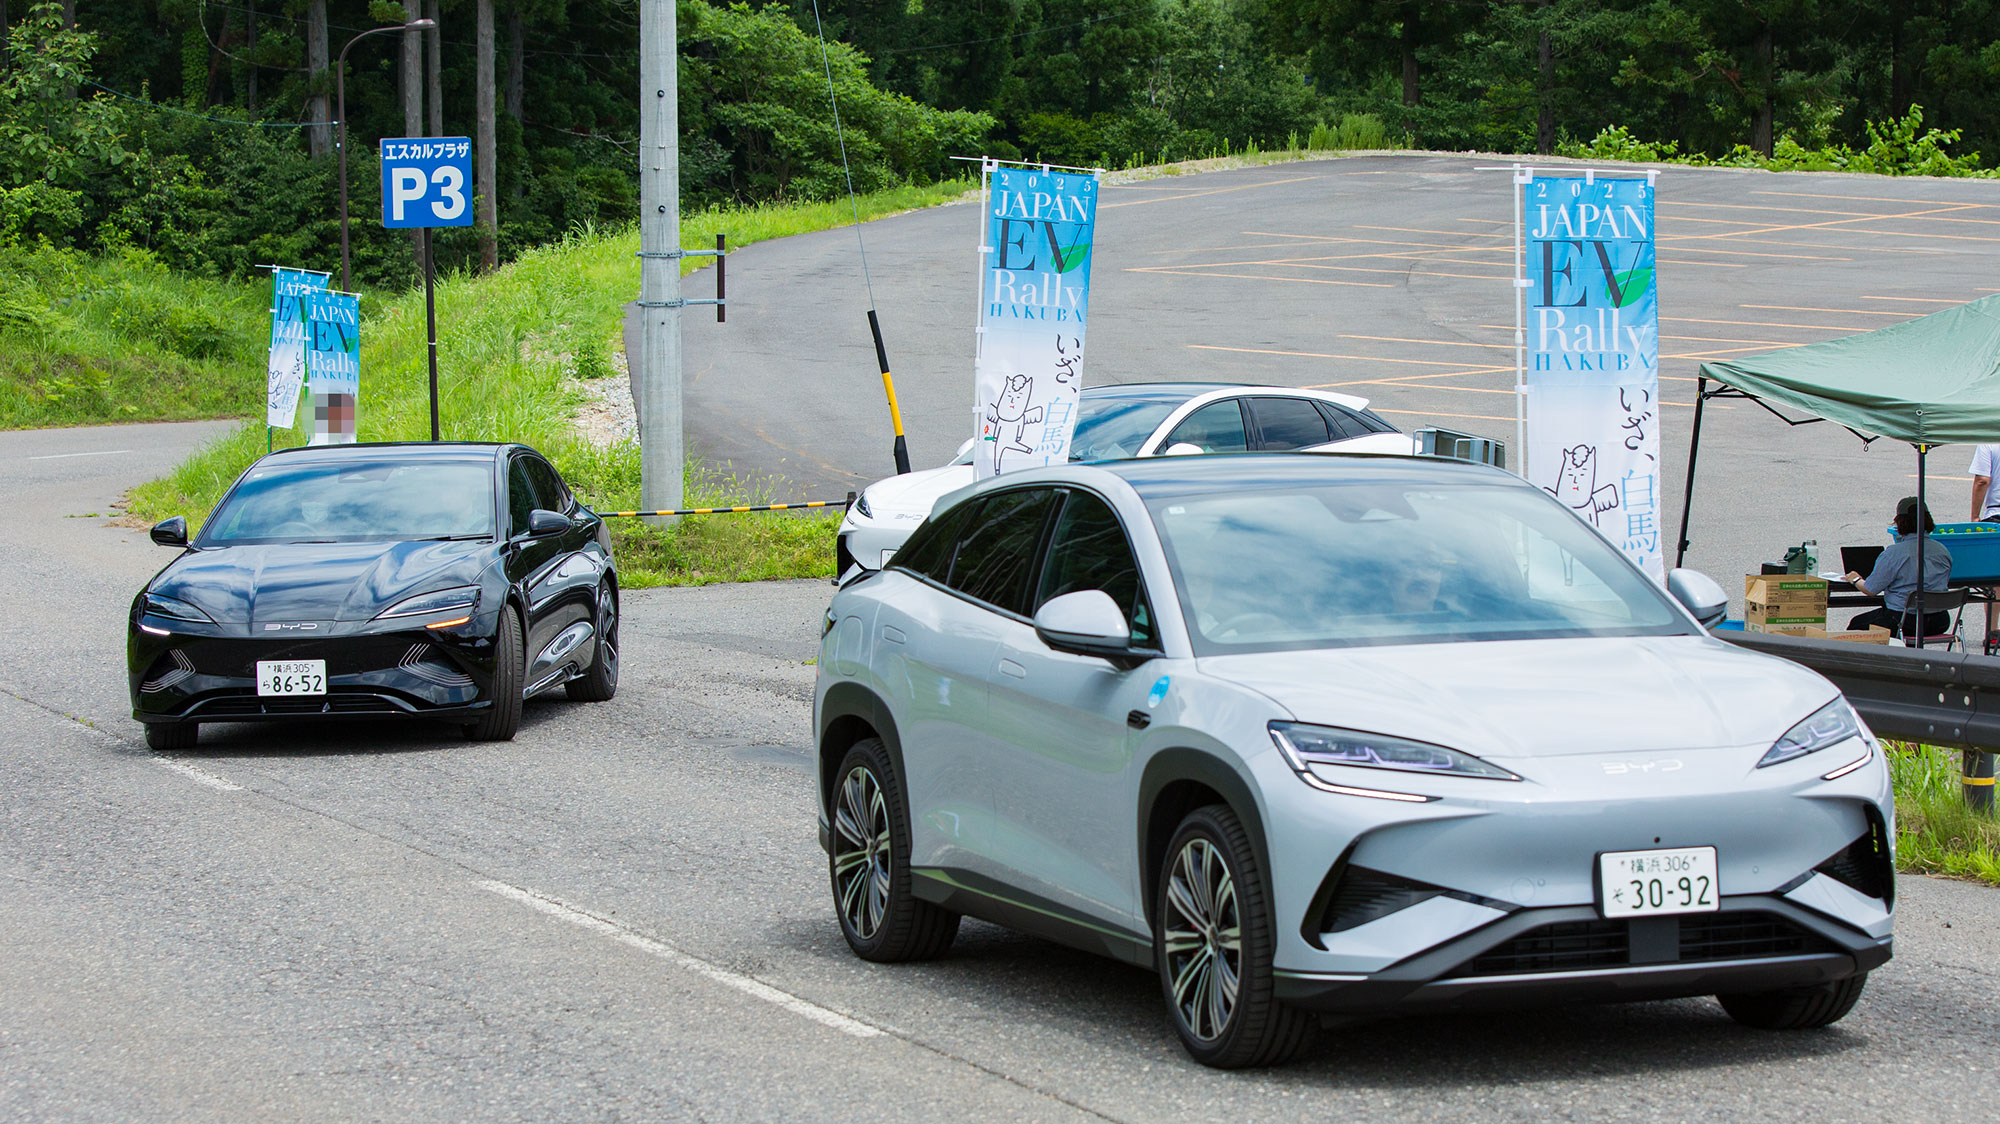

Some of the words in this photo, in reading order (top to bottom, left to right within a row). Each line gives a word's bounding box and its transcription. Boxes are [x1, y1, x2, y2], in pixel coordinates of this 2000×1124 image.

[385, 143, 469, 160] エスカルプラザ
[392, 165, 466, 220] P3
[1000, 174, 1092, 192] 2025
[1536, 183, 1646, 199] 2025
[994, 190, 1092, 222] JAPAN
[1532, 203, 1648, 239] JAPAN
[992, 217, 1089, 274] EV
[1532, 240, 1650, 309] EV
[311, 295, 357, 308] 2025
[990, 269, 1084, 320] Rally
[310, 303, 356, 327] JAPAN
[990, 303, 1082, 323] HAKUBA
[311, 320, 356, 353] EV
[1533, 308, 1648, 370] Rally
[310, 349, 358, 374] Rally
[1535, 353, 1650, 371] HAKUBA
[264, 623, 318, 631] BYD
[262, 680, 271, 690] ら
[272, 675, 323, 693] 86-52
[1630, 875, 1711, 909] 30-92
